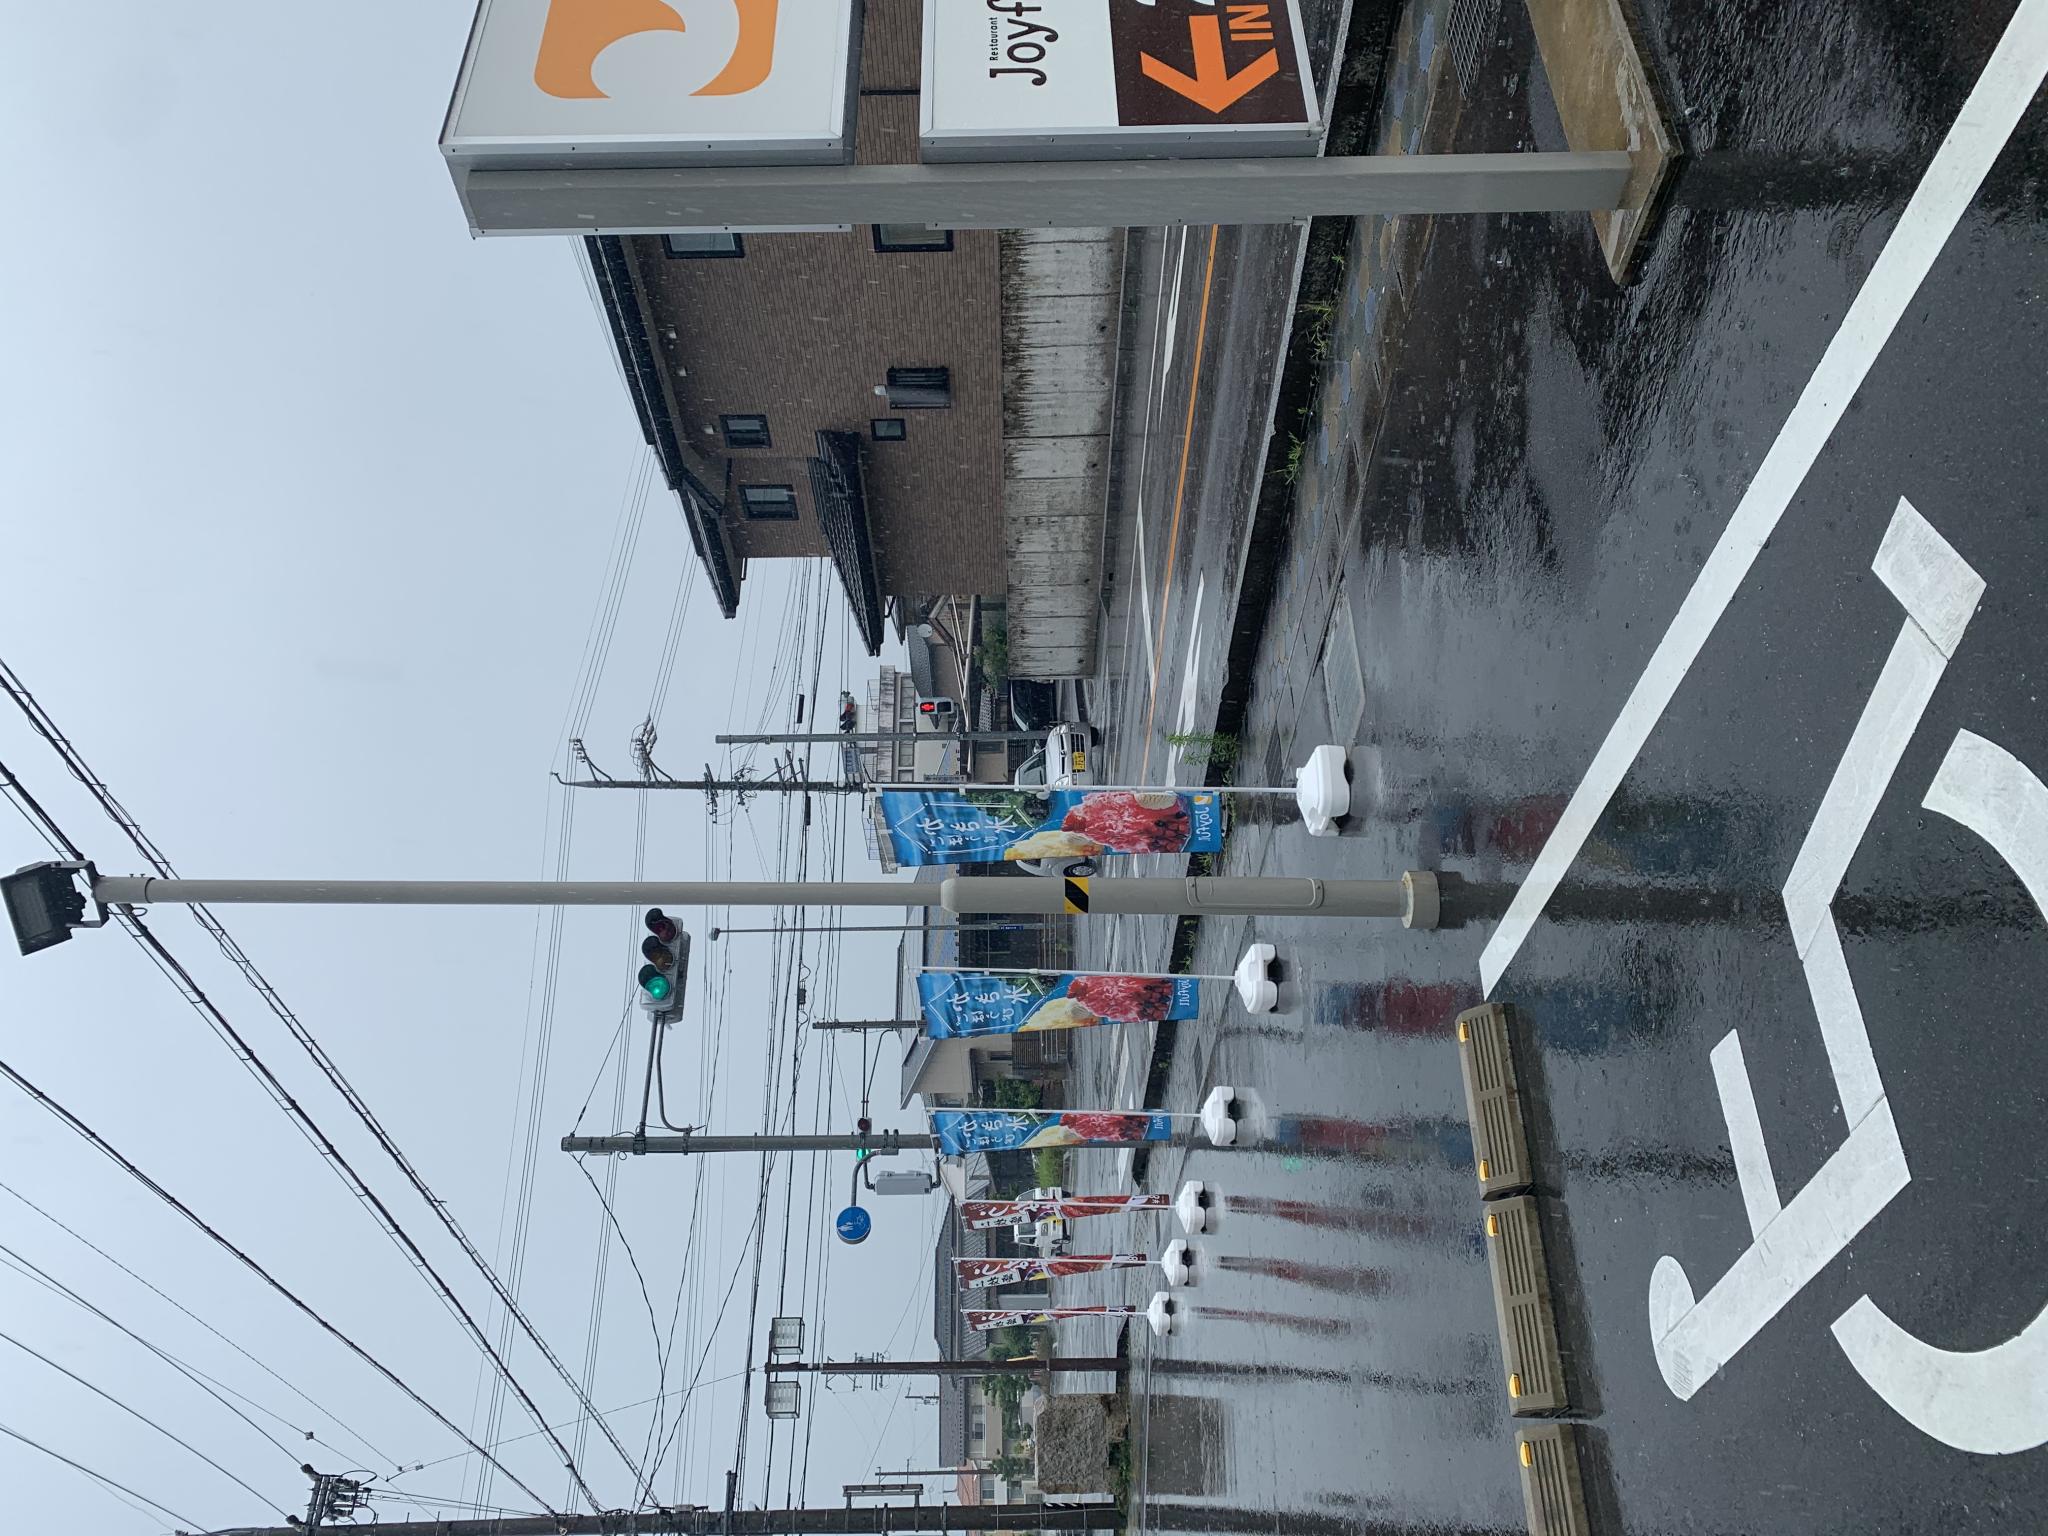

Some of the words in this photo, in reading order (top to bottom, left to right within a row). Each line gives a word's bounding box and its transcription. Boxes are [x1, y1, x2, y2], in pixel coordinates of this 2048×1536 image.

[986, 0, 1059, 86] Joyf
[988, 17, 999, 61] Restaurant
[1226, 4, 1274, 41] IN
